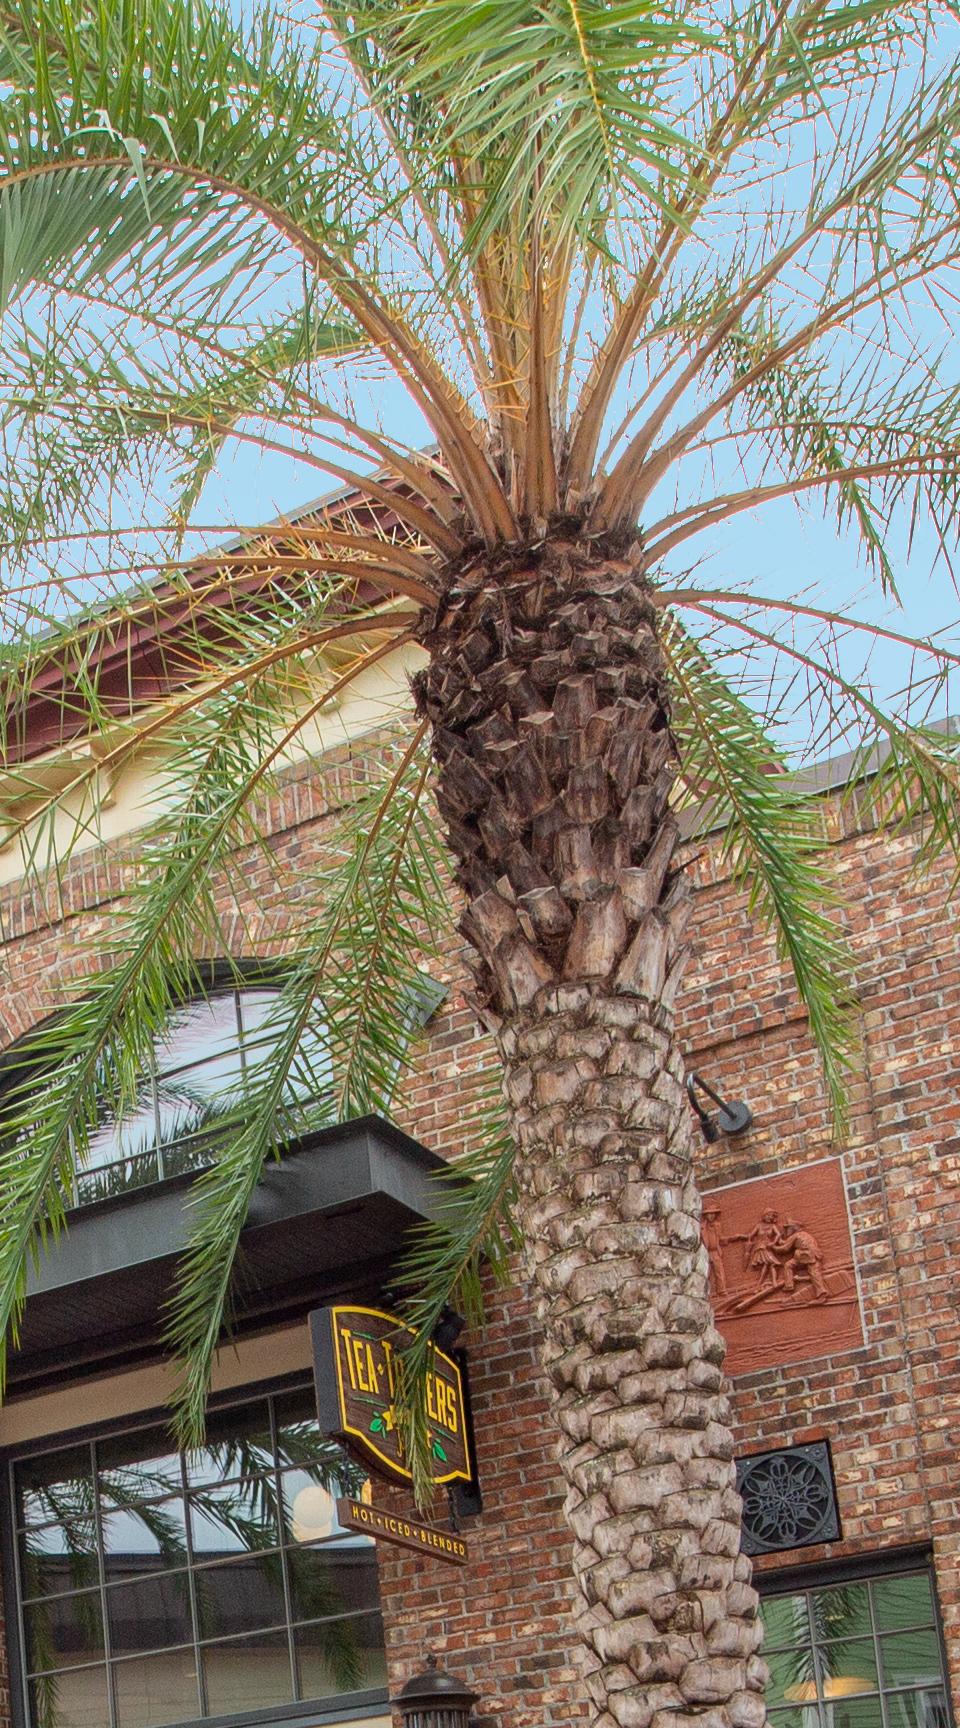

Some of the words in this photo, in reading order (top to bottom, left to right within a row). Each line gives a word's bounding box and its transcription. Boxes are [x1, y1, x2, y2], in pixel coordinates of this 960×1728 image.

[381, 1341, 458, 1433] TERS
[352, 1505, 374, 1524] HOT
[384, 1517, 410, 1537] ICED
[420, 1530, 465, 1557] BLENDED
